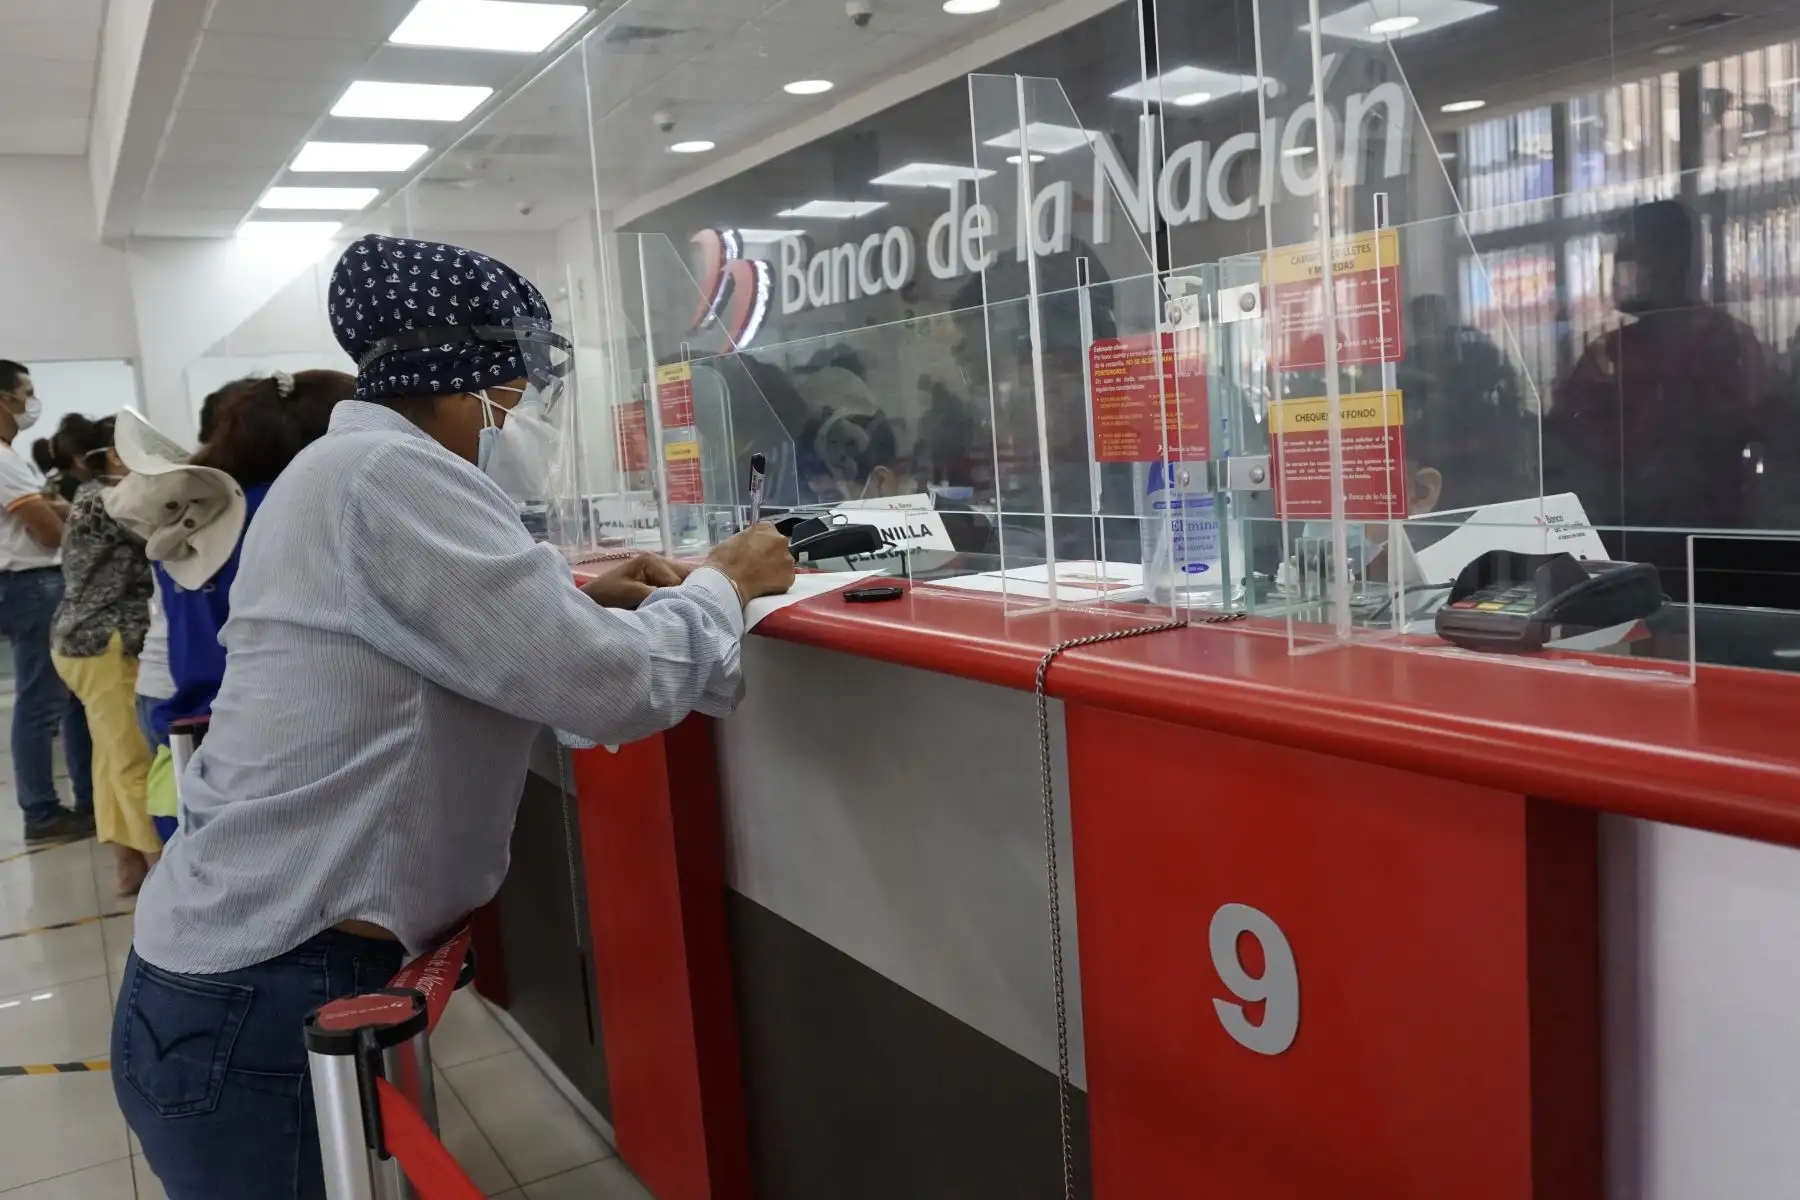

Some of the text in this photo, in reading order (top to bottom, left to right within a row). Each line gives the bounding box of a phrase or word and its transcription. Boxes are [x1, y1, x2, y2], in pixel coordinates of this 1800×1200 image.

[779, 52, 1413, 315] Banco de la Nación
[1314, 261, 1354, 274] MEDAS
[1346, 408, 1376, 420] FONDO
[1171, 519, 1219, 532] Elmina
[1209, 903, 1301, 1056] 9
